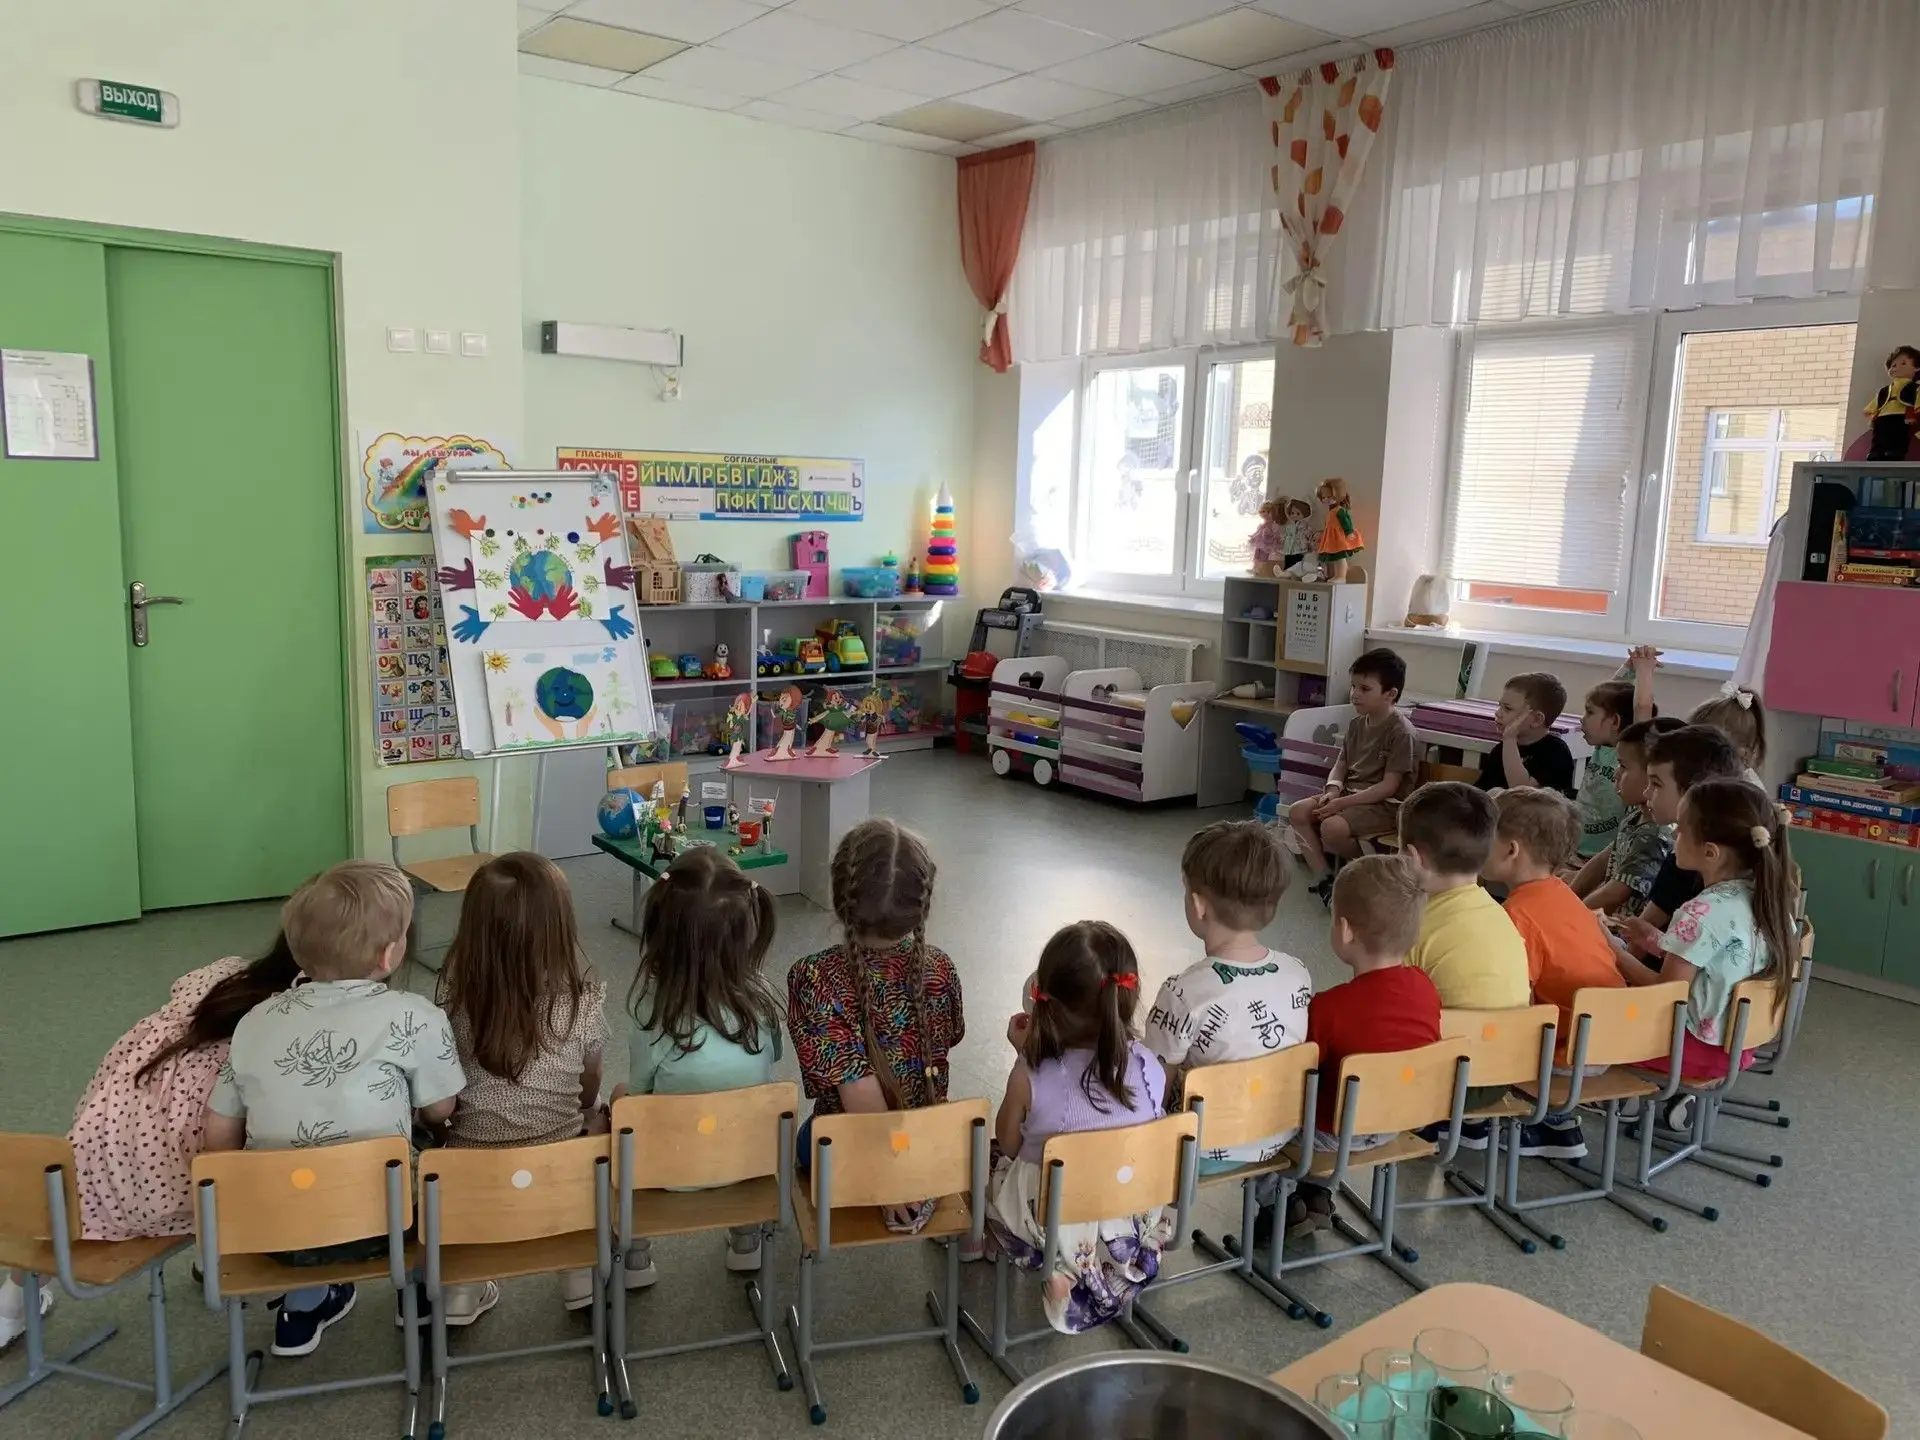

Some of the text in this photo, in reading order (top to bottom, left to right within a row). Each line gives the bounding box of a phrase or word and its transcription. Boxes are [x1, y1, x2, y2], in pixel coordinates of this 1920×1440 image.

[102, 86, 158, 112] ВЫХОД
[575, 450, 623, 459] ГЛАСНЫЕ
[723, 455, 778, 464] СОГЛАСНЫЕ
[404, 572, 413, 583] Б
[407, 625, 416, 637] К
[379, 656, 389, 668] О
[408, 654, 418, 665] П
[381, 685, 390, 696] У
[408, 683, 420, 693] Ф
[412, 737, 426, 748] Ю
[442, 734, 452, 745] Я
[1192, 1004, 1229, 1054] YEAH!!!
